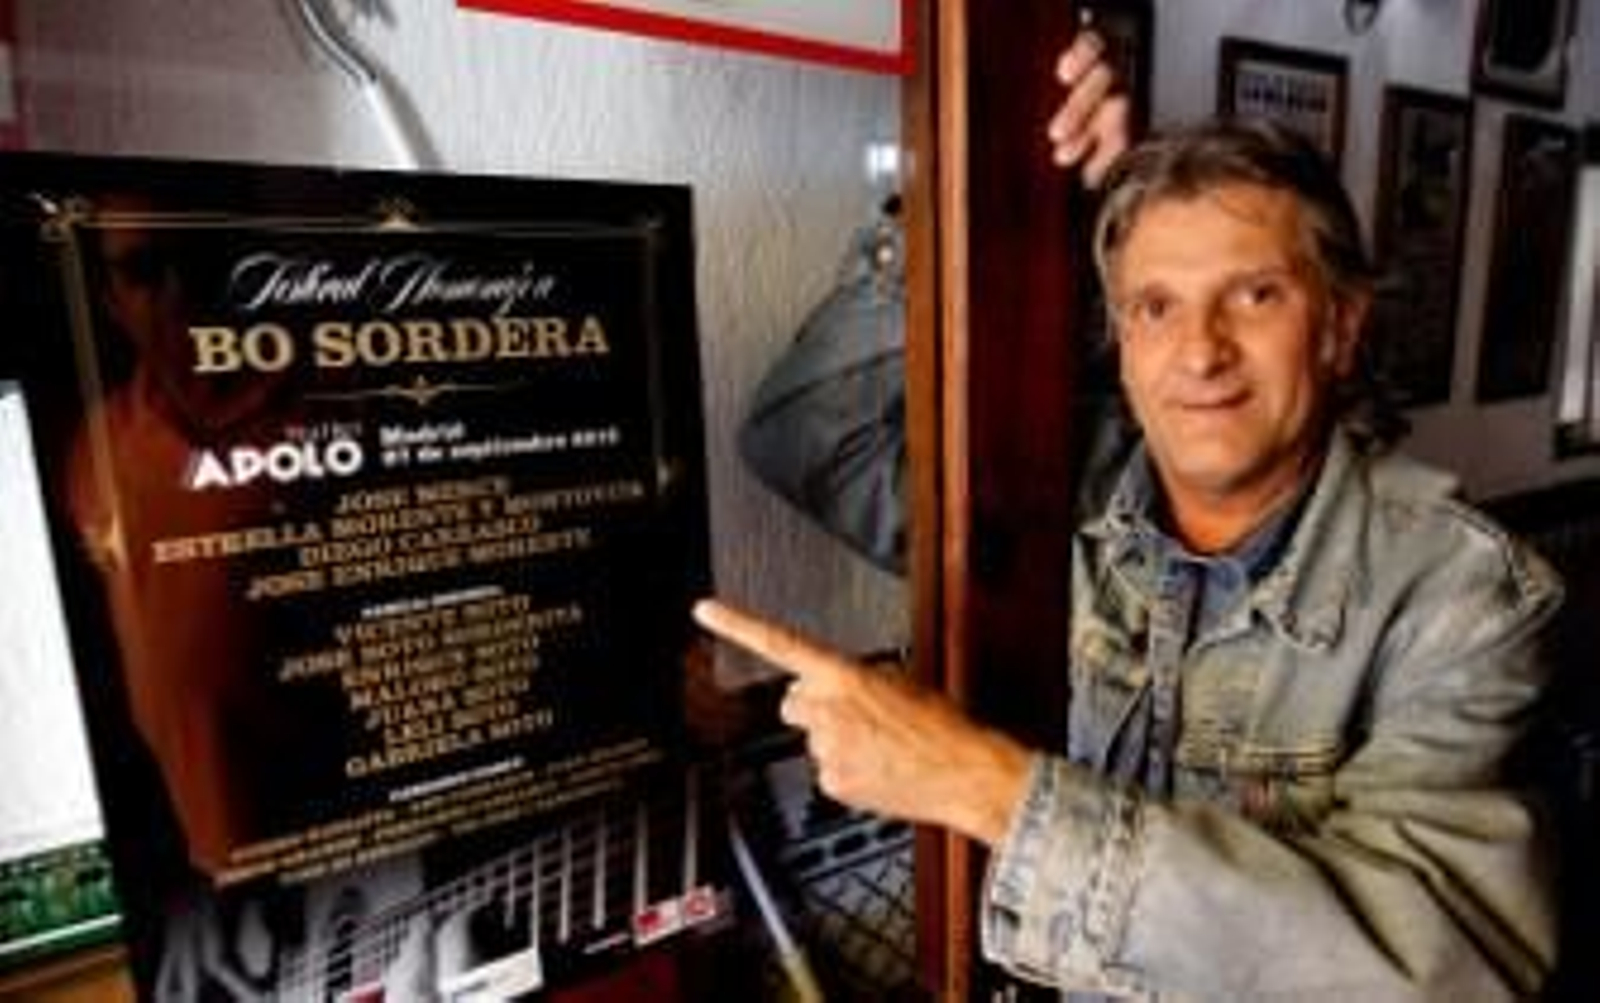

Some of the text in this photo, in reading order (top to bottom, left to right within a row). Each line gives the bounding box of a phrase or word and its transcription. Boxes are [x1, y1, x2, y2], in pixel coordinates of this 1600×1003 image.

[189, 314, 609, 373] BO SORDERA
[379, 420, 464, 446] Madrid
[188, 440, 363, 490] APOLO
[151, 522, 323, 564] ESTRELLA
